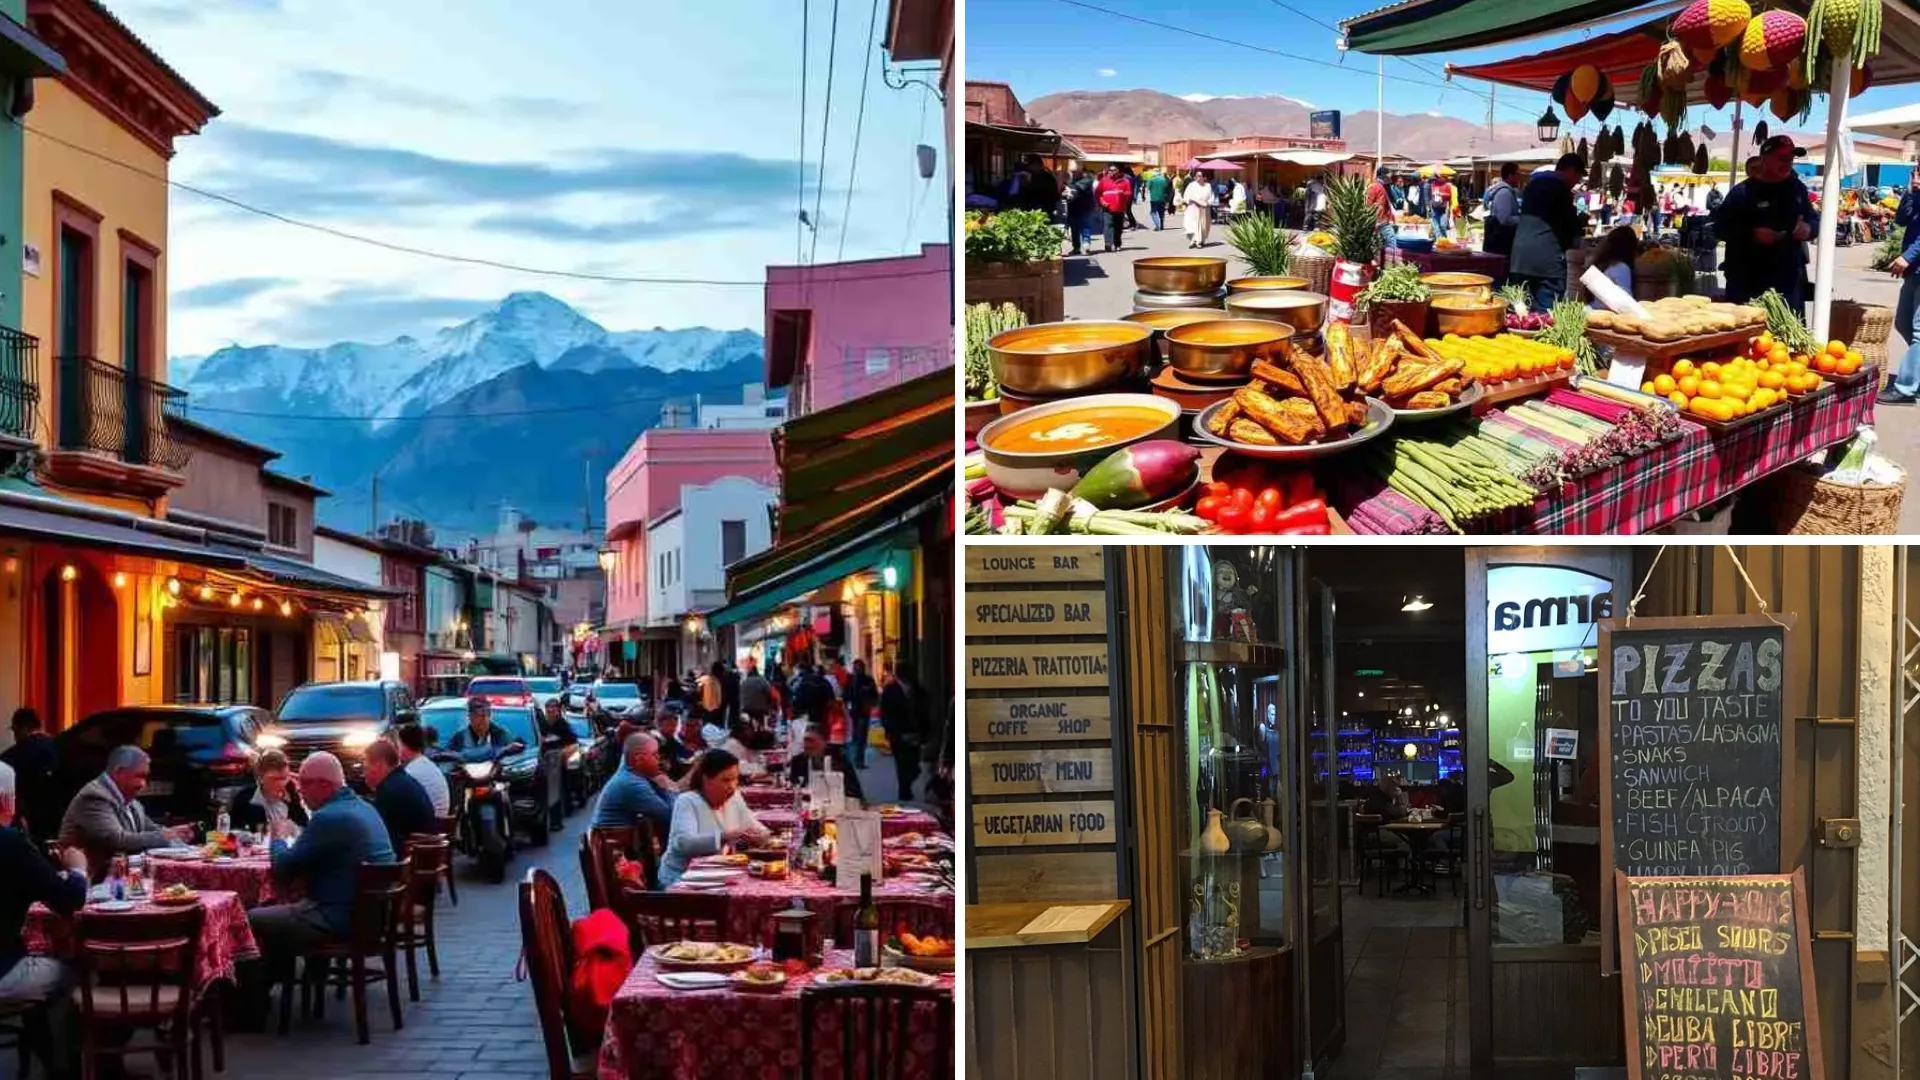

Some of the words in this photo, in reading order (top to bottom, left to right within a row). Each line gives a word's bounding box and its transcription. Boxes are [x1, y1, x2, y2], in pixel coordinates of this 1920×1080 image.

[983, 557, 1035, 570] LOUNGE
[1053, 556, 1079, 569] BAR
[977, 603, 1055, 624] SPECIALIZED
[1064, 603, 1091, 622] BAR
[972, 657, 1028, 677] PIZZERIA
[1612, 638, 1782, 695] PIZZAS
[1010, 703, 1067, 719] ORGANIC
[1611, 699, 1641, 722] TO
[1653, 697, 1689, 722] YOU
[1698, 694, 1768, 720] TASTE
[988, 721, 1028, 736] COFFE
[1058, 719, 1091, 734] SHOP
[1622, 747, 1687, 765] SNAKS
[991, 762, 1042, 782] TOURIST
[1056, 761, 1092, 781] MENU
[1623, 764, 1710, 788] SANWICH
[1627, 782, 1775, 810] BEEF/ALPACA
[984, 814, 1063, 834] VEGETARIAN
[1070, 813, 1105, 832] FOOD
[1626, 812, 1678, 836] FISH
[1628, 839, 1702, 862] GUINEA
[1712, 840, 1744, 862] PIG
[1648, 926, 1704, 955] PISCO
[1717, 925, 1792, 955] SOURS
[1656, 988, 1778, 1018] CHILCANO
[1657, 1015, 1715, 1043] CUBA
[1732, 1019, 1801, 1051] LIBRE
[1732, 1048, 1801, 1080] LIBRE
